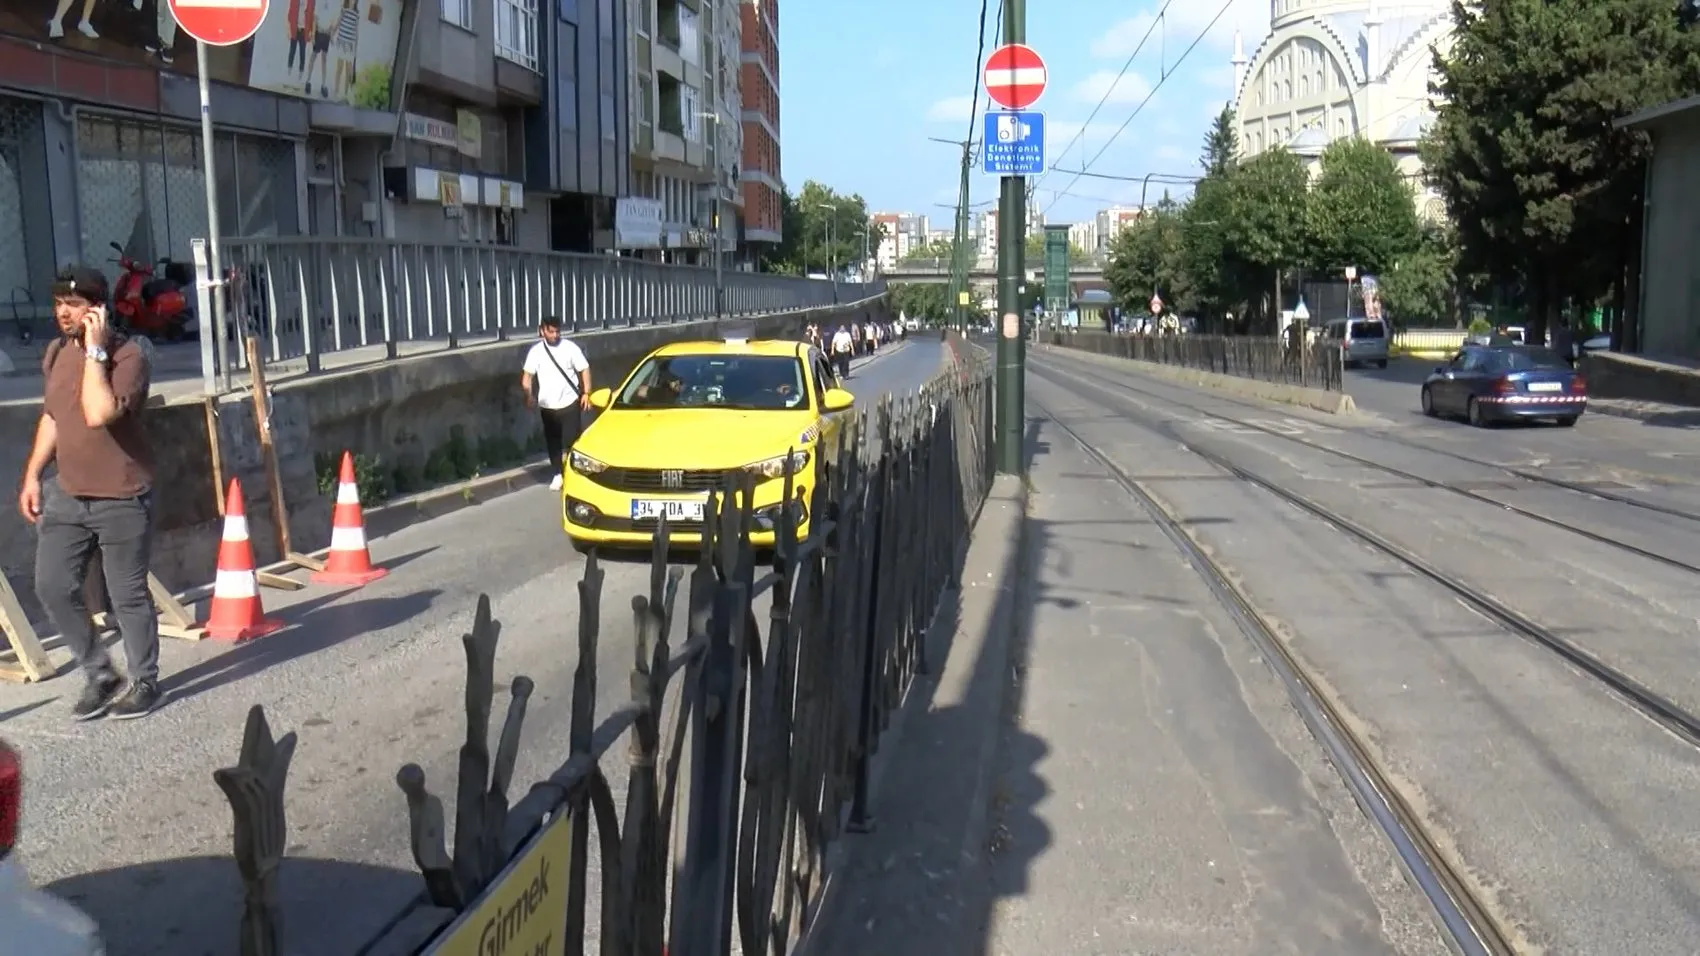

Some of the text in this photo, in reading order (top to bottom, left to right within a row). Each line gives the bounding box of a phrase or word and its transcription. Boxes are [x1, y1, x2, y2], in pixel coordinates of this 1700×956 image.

[988, 144, 1039, 153] Elektronik
[987, 153, 1041, 162] Denetleme
[995, 162, 1032, 170] Sistemi
[661, 469, 684, 488] FIAT
[640, 502, 653, 515] 34
[662, 502, 684, 515] TDA
[478, 855, 550, 956] Girmek
